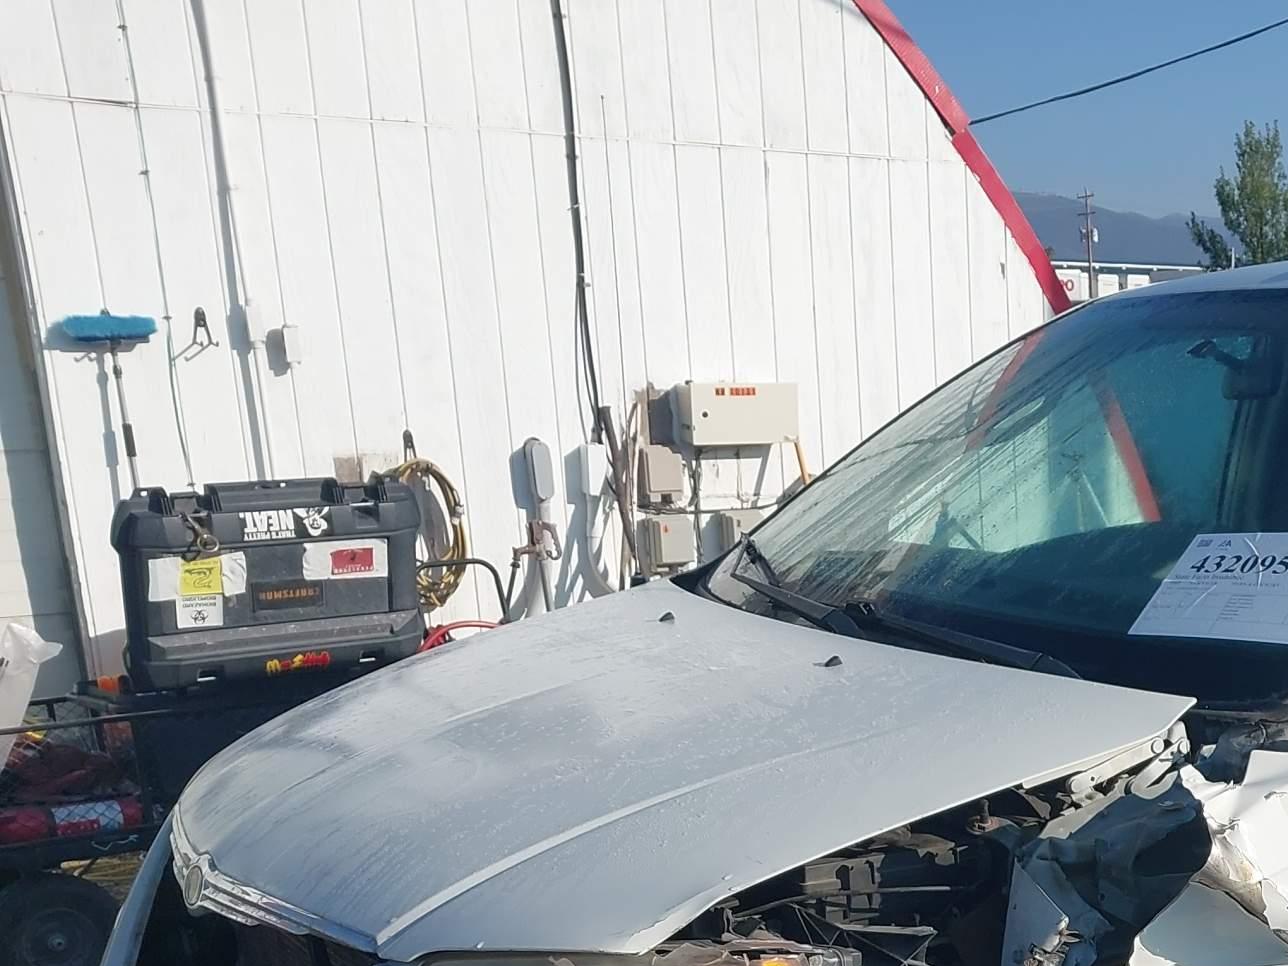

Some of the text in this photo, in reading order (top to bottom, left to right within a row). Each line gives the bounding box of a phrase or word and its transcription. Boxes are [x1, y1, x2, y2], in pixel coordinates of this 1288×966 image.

[239, 509, 294, 532] NEAT.
[243, 530, 296, 541] THAT'S PRETTY
